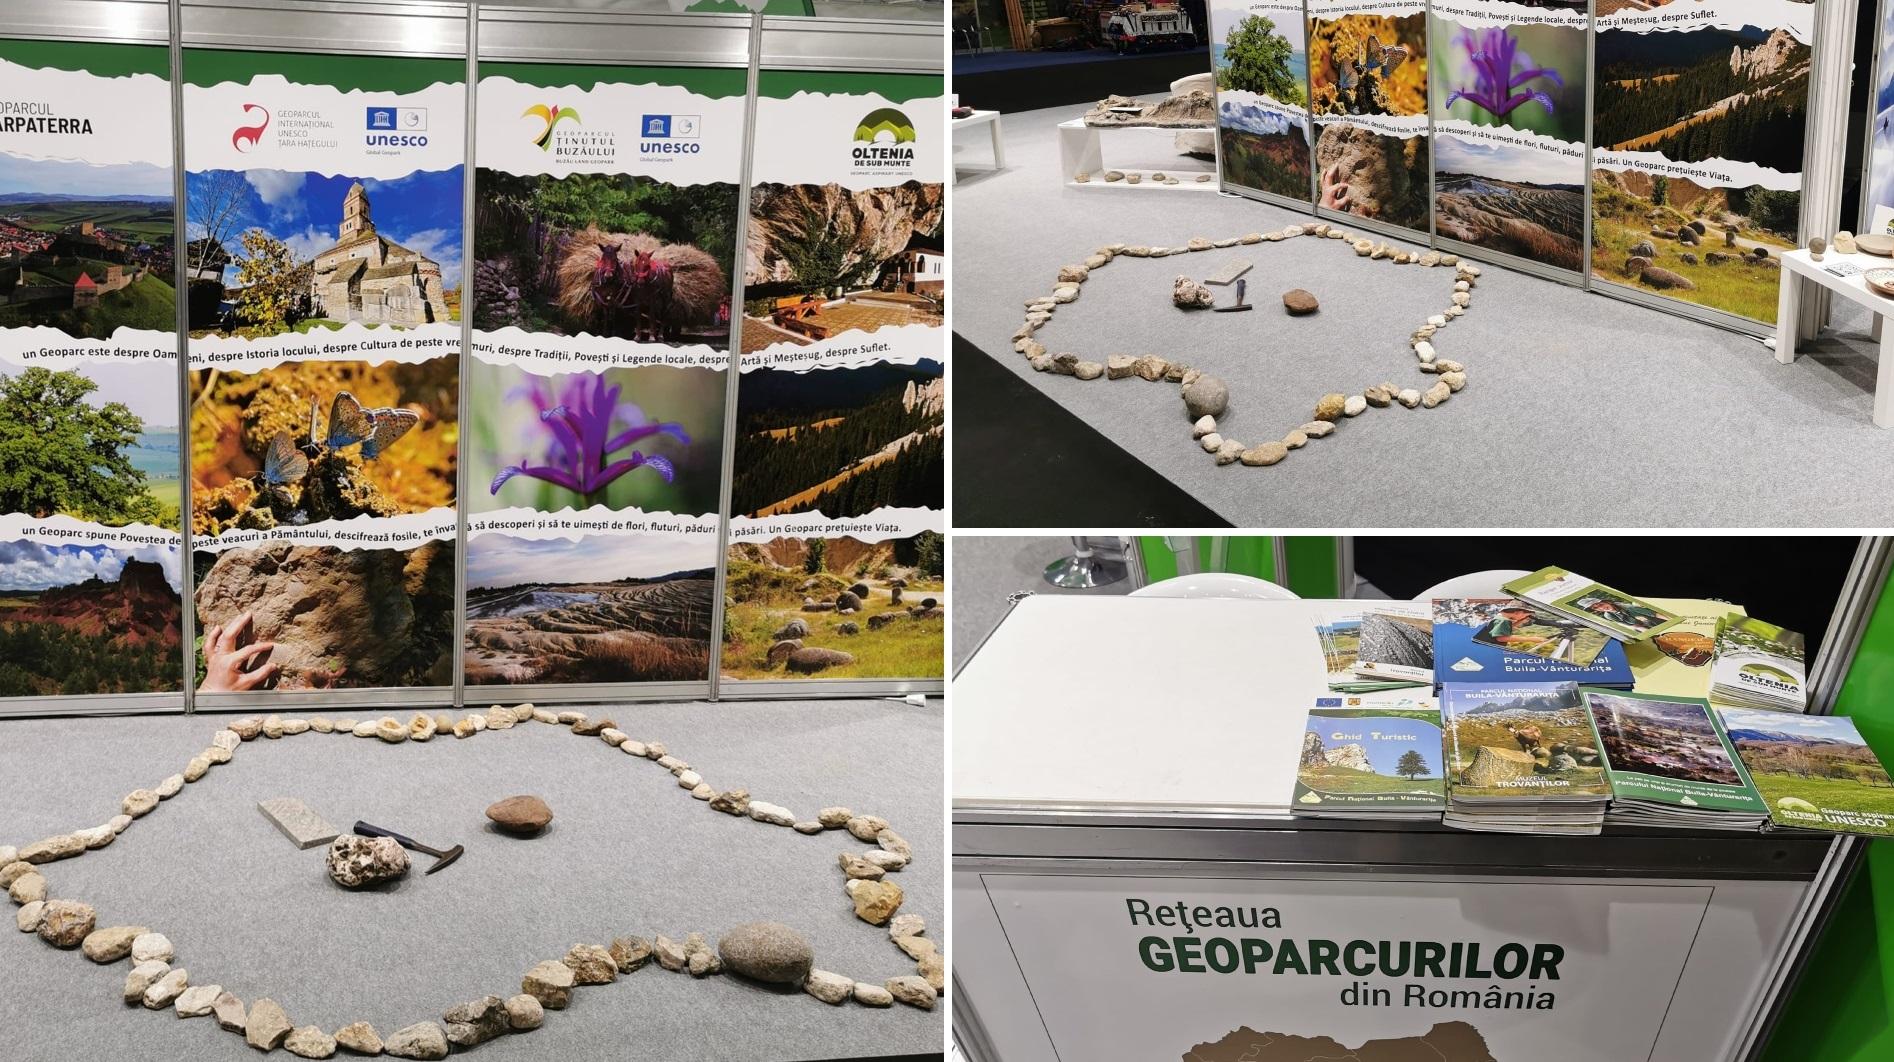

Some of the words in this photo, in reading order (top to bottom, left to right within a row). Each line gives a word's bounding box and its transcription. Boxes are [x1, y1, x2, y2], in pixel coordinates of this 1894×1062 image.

[1518, 15, 1542, 25] Legende
[1662, 12, 1689, 24] despre
[1690, 9, 1717, 20] Suflet.
[277, 110, 321, 119] GEOPARCUL
[277, 130, 308, 138] UNESCO
[366, 134, 429, 147] unesco
[556, 138, 616, 147] ȚINUTUL
[556, 147, 616, 156] BUZĂULUI
[640, 141, 700, 154] unesco
[852, 147, 914, 159] OLTENIA
[854, 159, 865, 167] DE
[866, 159, 882, 167] SUB
[1515, 137, 1523, 146] de
[1562, 147, 1583, 159] păduri
[1634, 160, 1666, 171] Geoparc
[1667, 164, 1707, 178] prețuiește
[1709, 170, 1733, 183] Viața.
[22, 349, 37, 359] un
[40, 347, 85, 359] Geoparc
[88, 347, 110, 356] este
[114, 346, 150, 359] despre
[208, 350, 243, 364] despre
[246, 348, 279, 360] Istoria
[282, 345, 321, 359] locului,
[323, 342, 358, 355] despre
[360, 339, 397, 352] Cultura
[400, 338, 412, 348] de
[415, 337, 442, 349] peste
[498, 345, 531, 359] despre
[534, 348, 572, 362] Tradiții,
[574, 351, 610, 364] Povești
[611, 352, 620, 364] și
[623, 353, 664, 366] Legende
[665, 354, 697, 366] locale,
[699, 354, 730, 367] despre
[741, 356, 761, 367] Artă
[763, 355, 771, 366] și
[825, 346, 858, 360] despre
[860, 342, 890, 354] Suflet.
[22, 527, 36, 536] un
[39, 526, 83, 539] Geoparc
[85, 531, 117, 543] spune
[120, 532, 166, 545] Povestea
[169, 535, 182, 546] de
[192, 538, 220, 550] peste
[222, 532, 259, 546] veacuri
[262, 531, 268, 540] a
[271, 529, 332, 542] Pământului,
[334, 530, 389, 543] descifrează
[392, 529, 421, 543] fosile,
[423, 528, 433, 537] te
[475, 520, 486, 530] să
[488, 519, 536, 532] descoperi
[538, 519, 545, 531] și
[548, 519, 559, 529] să
[561, 520, 571, 529] te
[573, 519, 609, 532] uimești
[612, 519, 624, 530] de
[626, 519, 647, 532] flori,
[650, 521, 683, 533] fluturi,
[685, 522, 716, 535] păduri
[734, 526, 766, 539] păsări.
[769, 526, 782, 535] Un
[784, 524, 823, 536] Geoparc
[825, 524, 873, 536] prețuiește
[875, 523, 901, 536] Viața.
[1503, 656, 1545, 664] Parcul
[1505, 664, 1613, 674] Buila-Vânturarița
[1739, 673, 1799, 692] OLTENIA
[1331, 731, 1362, 741] Ghid
[1370, 731, 1417, 741] Turistic
[1495, 780, 1570, 789] TROVANȚILOR
[1820, 807, 1860, 819] Geoparc
[1824, 815, 1887, 828] UNESCO
[1137, 935, 1567, 981] GEOPARCURILOR
[1339, 981, 1391, 1008] din
[1402, 984, 1556, 1011] România
